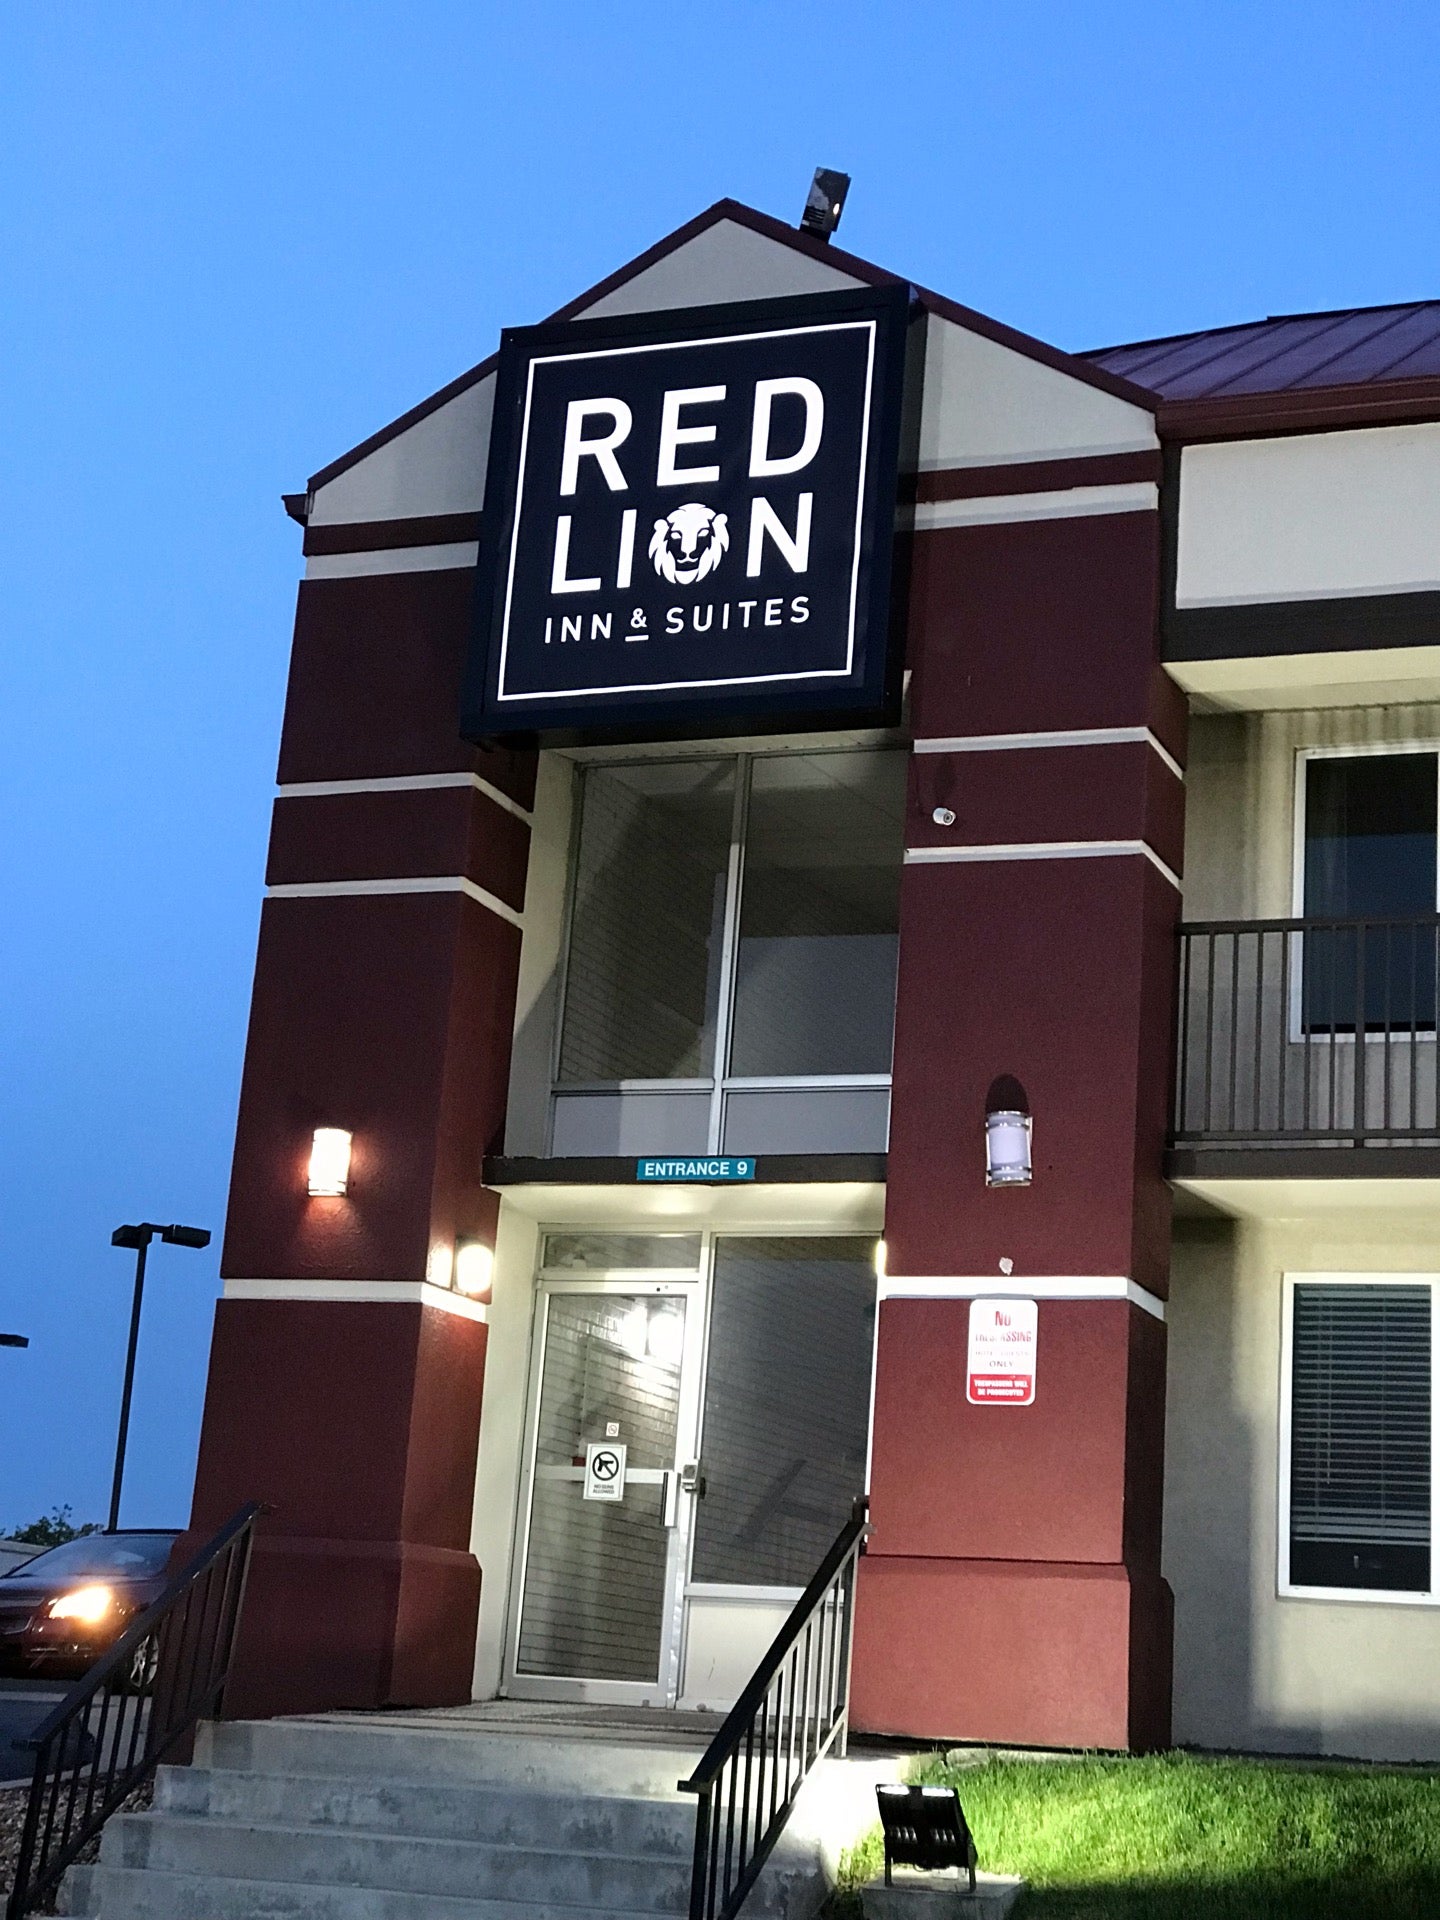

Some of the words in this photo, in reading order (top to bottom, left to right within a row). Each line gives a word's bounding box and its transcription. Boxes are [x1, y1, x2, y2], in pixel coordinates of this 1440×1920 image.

[559, 376, 824, 496] RED
[544, 612, 613, 644] INN
[625, 607, 650, 643] &
[665, 596, 811, 635] SUITES
[644, 1161, 730, 1177] ENTRANCE
[736, 1161, 748, 1176] 9
[994, 1310, 1012, 1326] NO
